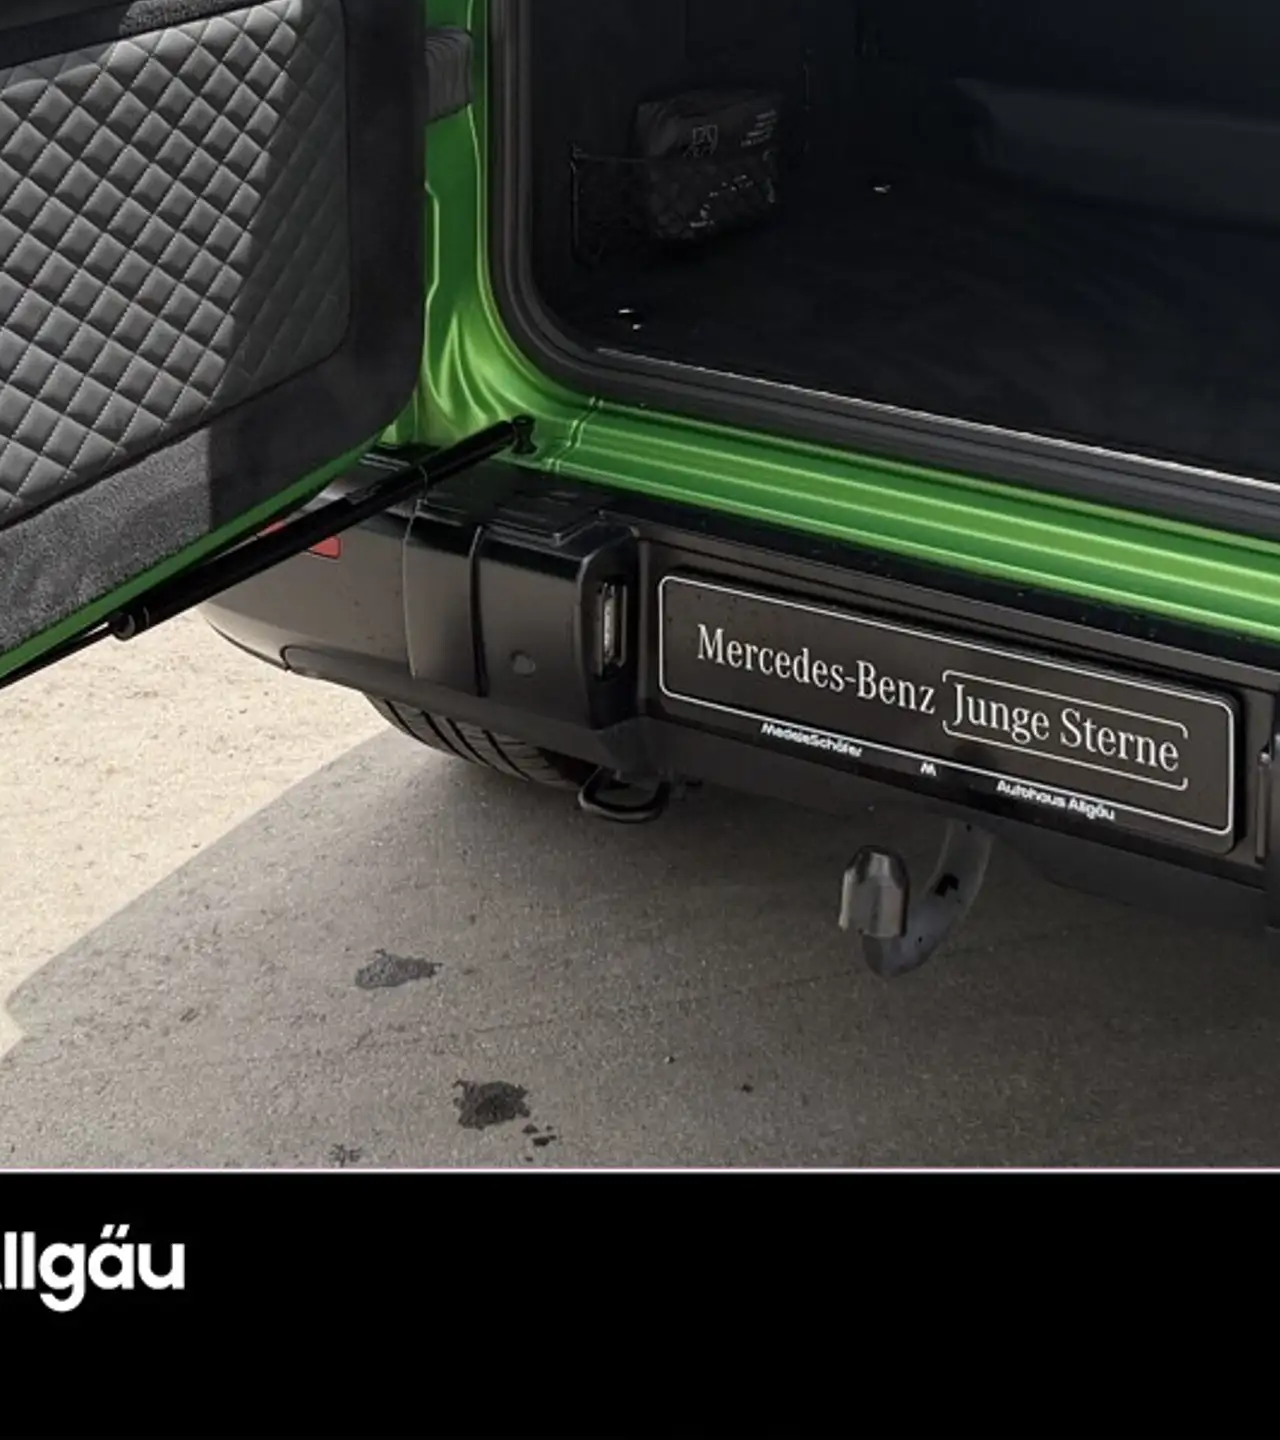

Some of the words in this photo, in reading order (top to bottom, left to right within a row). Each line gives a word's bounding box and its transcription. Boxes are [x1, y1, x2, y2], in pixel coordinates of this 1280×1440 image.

[697, 624, 936, 715] Mercedes-Benz
[952, 684, 1049, 743] Junge
[1060, 709, 1179, 771] Sterne
[995, 779, 1066, 808] Autohaus
